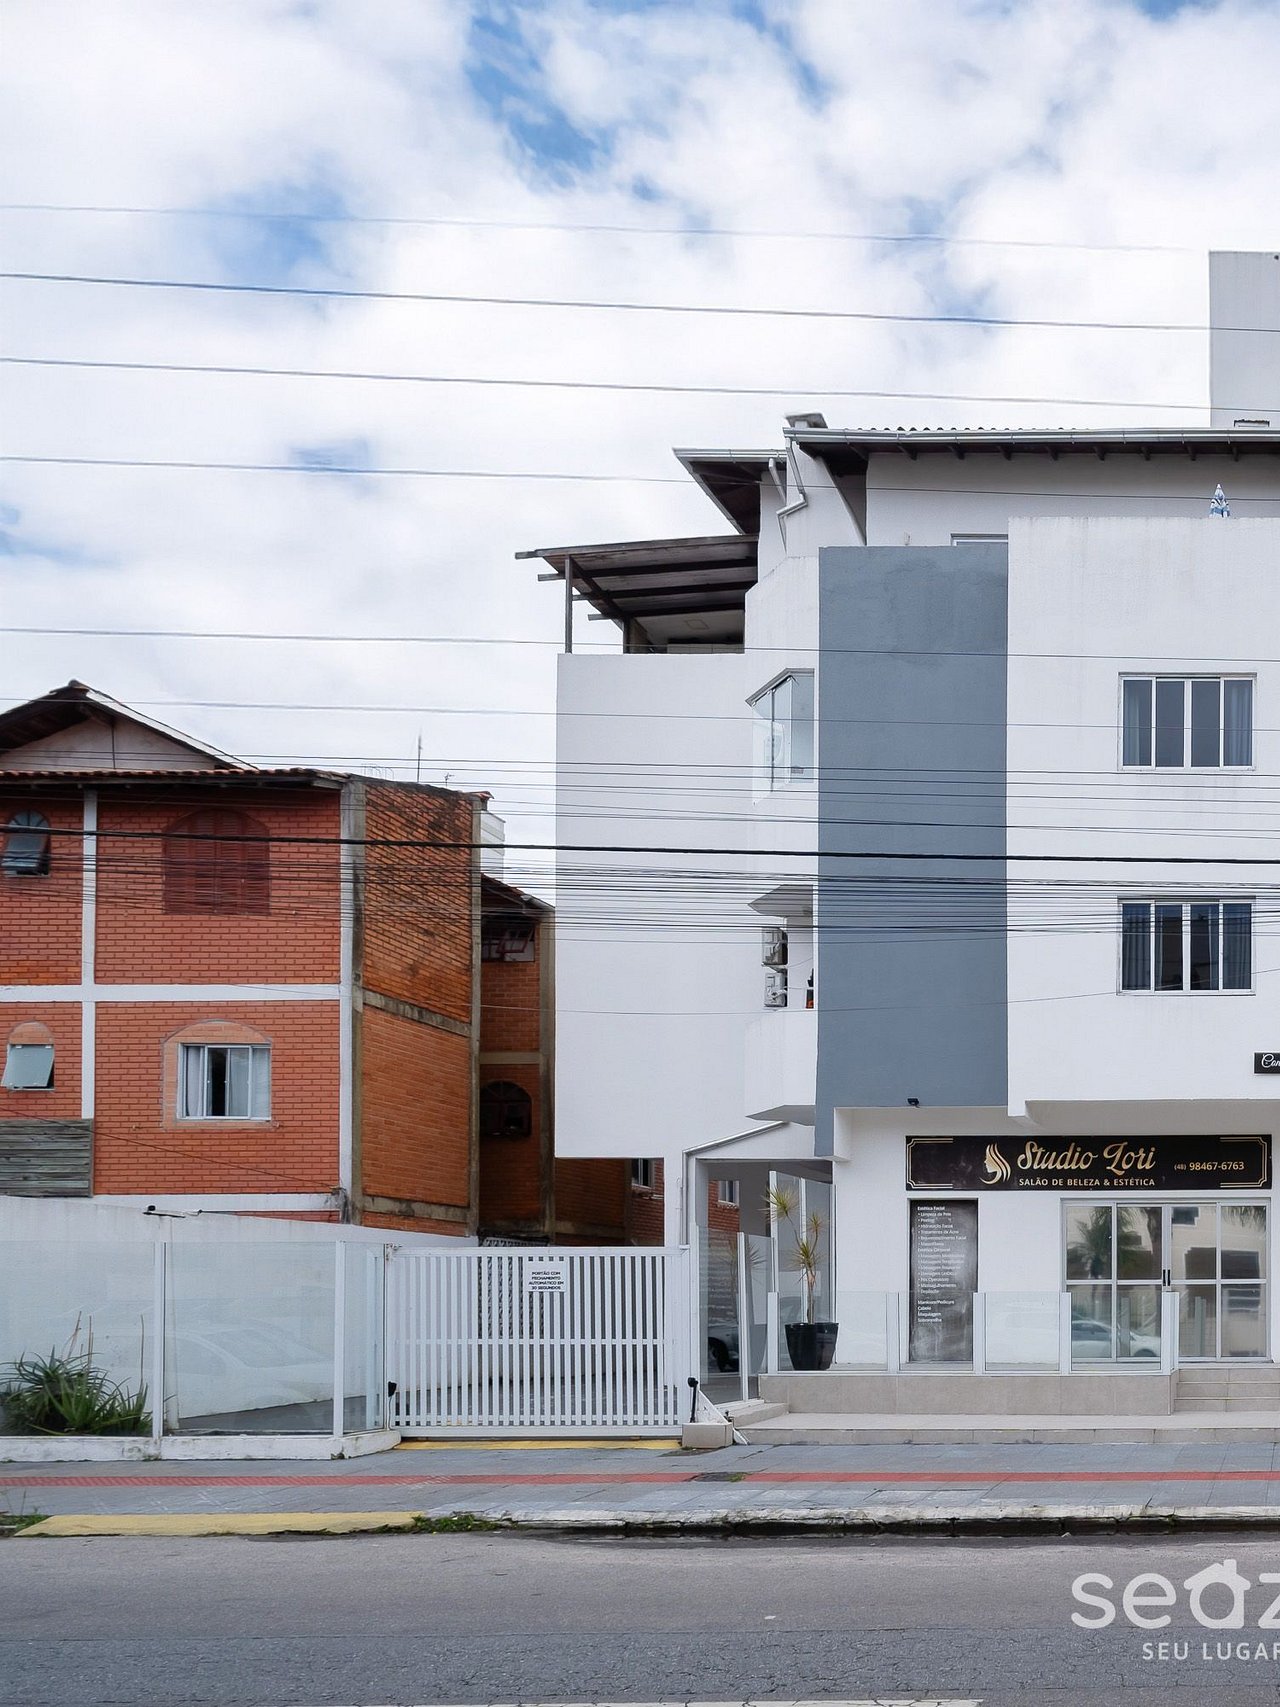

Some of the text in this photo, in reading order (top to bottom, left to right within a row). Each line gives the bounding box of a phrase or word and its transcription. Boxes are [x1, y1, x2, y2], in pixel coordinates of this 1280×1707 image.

[1017, 1141, 1156, 1175] Studio Lori
[1189, 1161, 1245, 1171] 98467-6763
[1019, 1177, 1048, 1186] SALÃO
[1114, 1177, 1156, 1186] ESTÉTICA
